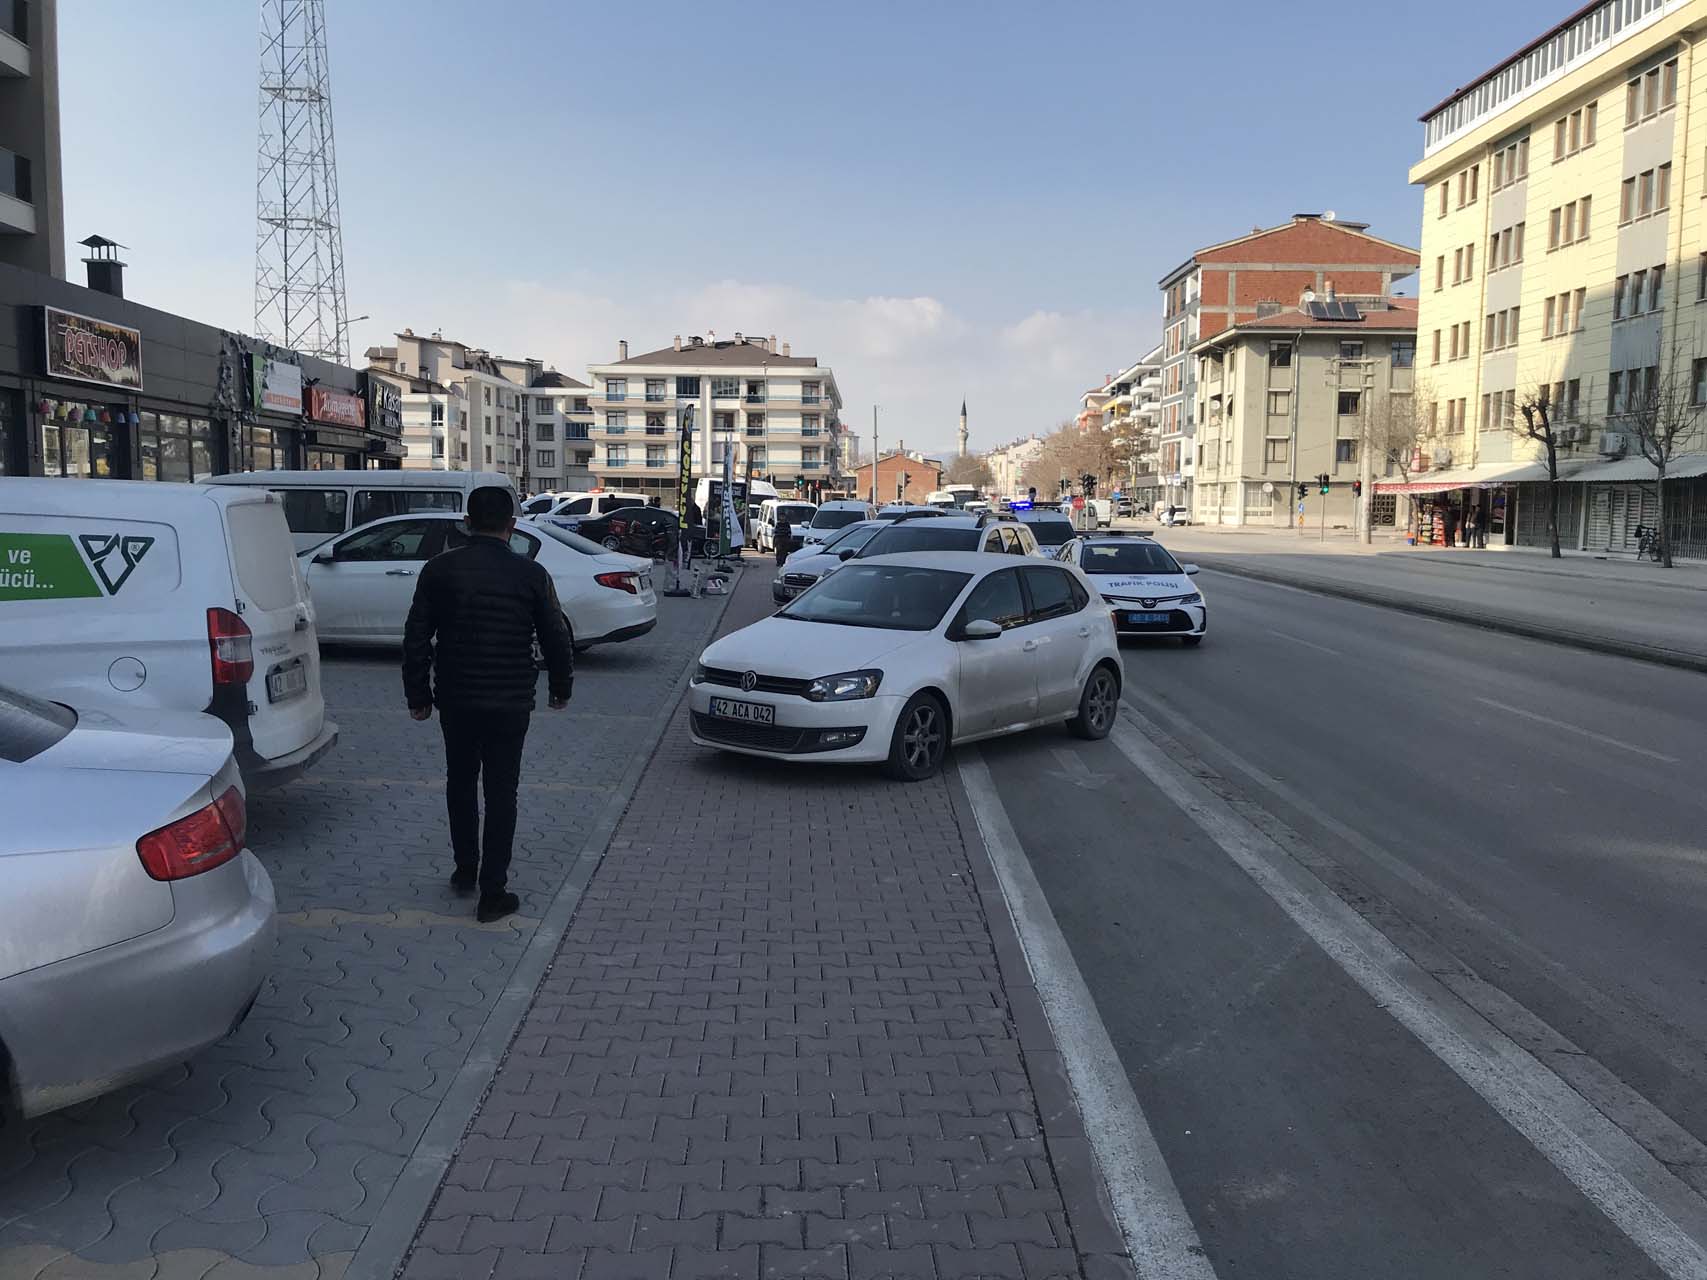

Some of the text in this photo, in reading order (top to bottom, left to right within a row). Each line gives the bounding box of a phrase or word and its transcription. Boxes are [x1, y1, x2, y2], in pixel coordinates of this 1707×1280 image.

[65, 328, 127, 371] PETSHOP
[8, 549, 31, 565] ve
[716, 701, 771, 722] 42 ACA 042
